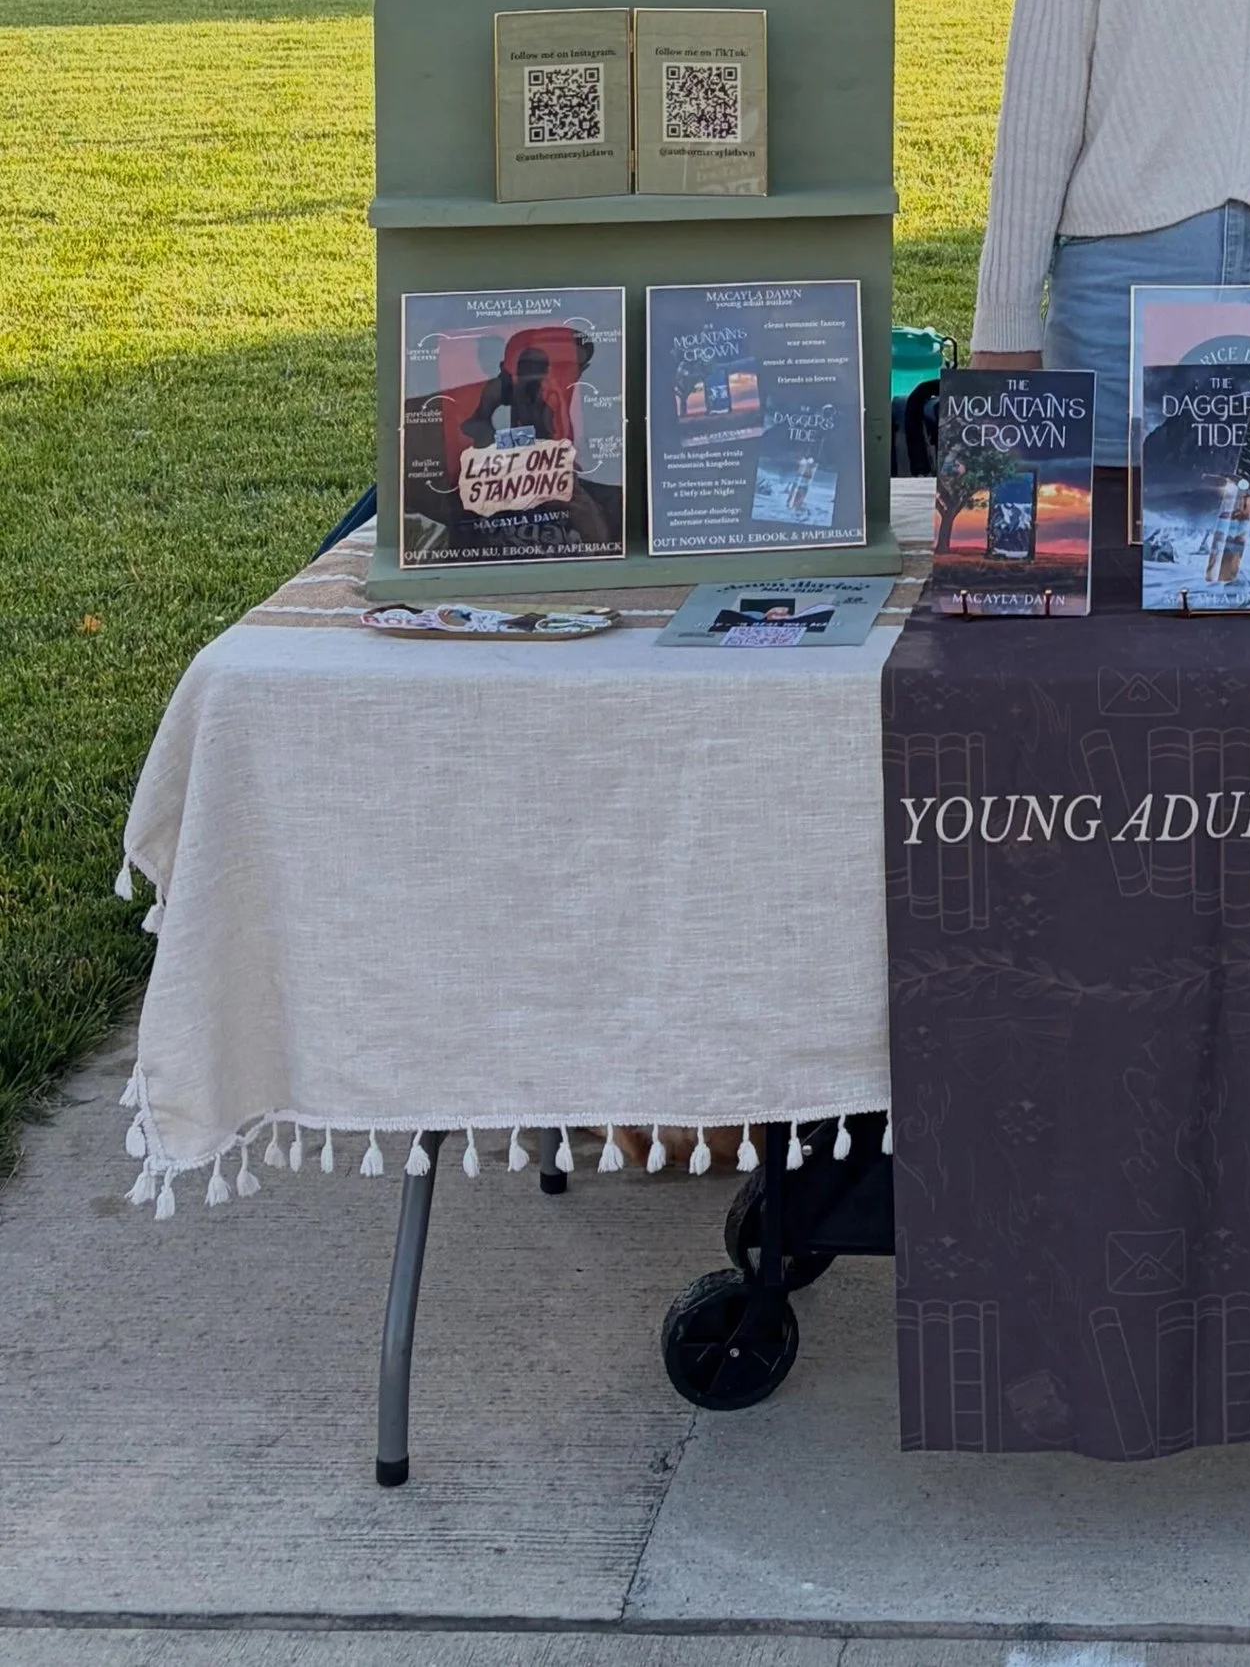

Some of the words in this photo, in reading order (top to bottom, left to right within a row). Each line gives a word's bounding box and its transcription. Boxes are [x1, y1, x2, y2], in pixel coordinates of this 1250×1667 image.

[511, 50, 538, 61] follow
[557, 51, 568, 59] on
[655, 47, 682, 57] follow
[706, 290, 763, 302] MACAYLA
[765, 289, 802, 300] DAWN
[467, 299, 524, 311] MACAYLA
[525, 298, 562, 309] DAWN
[716, 301, 742, 310] young
[765, 298, 793, 306] author
[475, 309, 501, 318] young
[503, 308, 523, 316] adult
[525, 307, 552, 315] author
[683, 343, 740, 362] CROWN
[1199, 347, 1238, 365] RICE
[777, 375, 804, 384] friends
[814, 374, 837, 382] lovers
[1006, 379, 1030, 391] THE
[1209, 377, 1233, 389] THE
[947, 393, 1086, 422] MOUNTAIN'S
[788, 428, 817, 443] TIDE
[961, 421, 1066, 452] CROWN
[1191, 423, 1248, 447] TIDE
[687, 449, 722, 460] kingdom
[465, 451, 520, 480] LAST
[526, 447, 569, 472] ONE
[469, 471, 571, 503] STANDING
[662, 480, 677, 489] The
[679, 488, 697, 499] Defy
[700, 488, 712, 496] the
[714, 487, 735, 497] Night
[473, 516, 529, 530] MACAYLA
[534, 510, 570, 523] DAWN
[653, 536, 677, 548] OUT
[679, 535, 707, 547] NOW
[709, 534, 726, 545] ON
[791, 531, 799, 540] &
[801, 528, 863, 540] PAPERBACK
[404, 549, 429, 561] OUT
[431, 548, 461, 560] NOW
[462, 547, 479, 558] ON
[546, 544, 555, 553] &
[557, 541, 622, 554] PAPERBACK
[952, 593, 1018, 605] MACAYLA
[900, 794, 1103, 845] YOUNG
